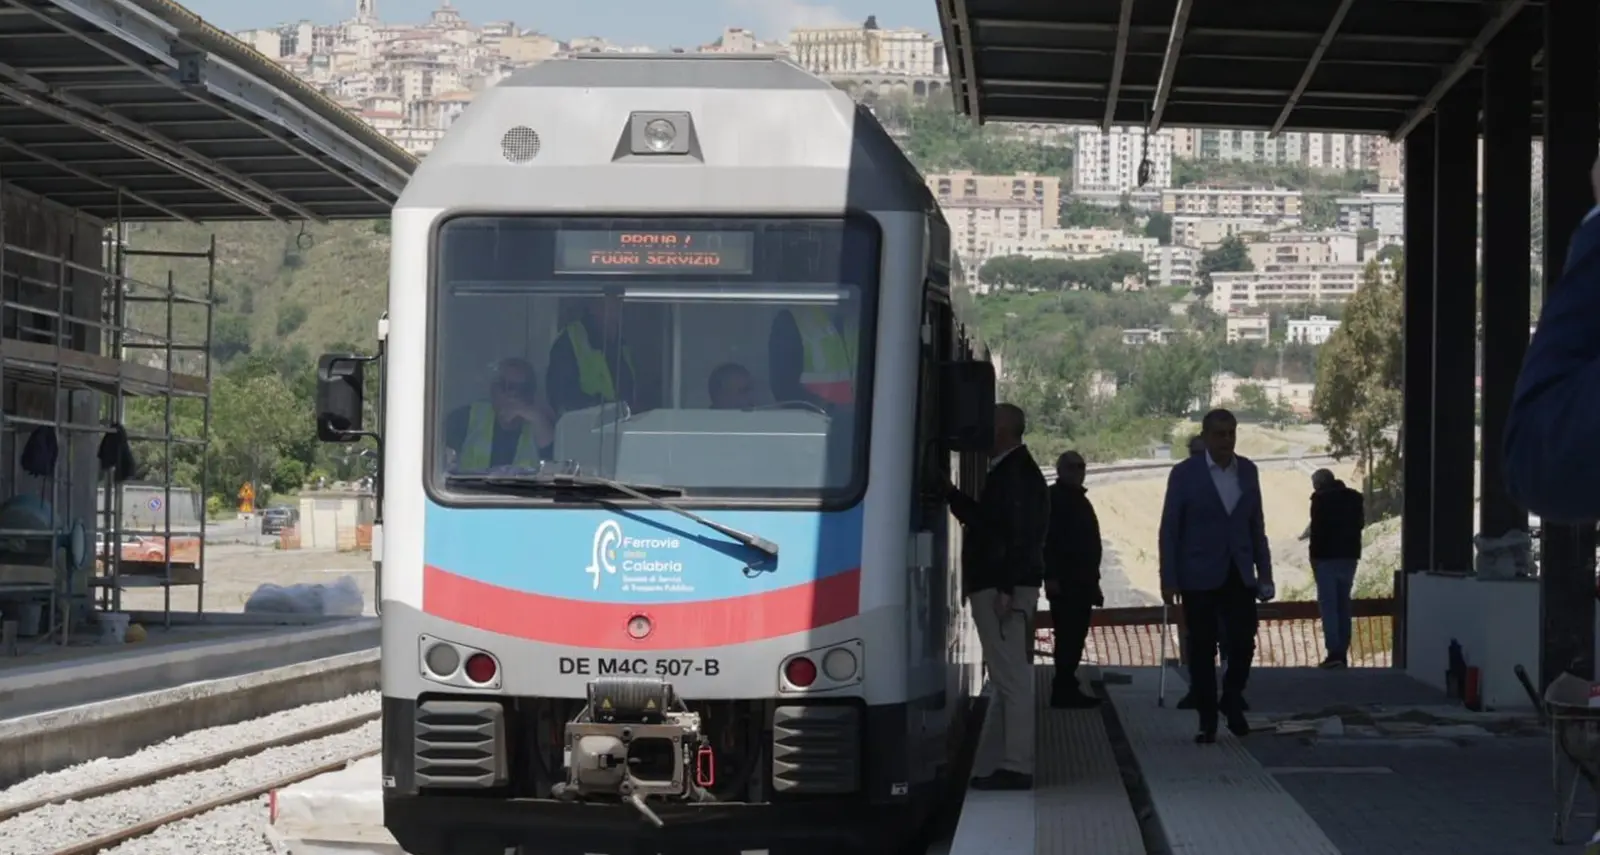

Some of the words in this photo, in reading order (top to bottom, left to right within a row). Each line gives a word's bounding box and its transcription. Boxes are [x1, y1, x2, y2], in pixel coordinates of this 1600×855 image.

[590, 250, 639, 264] FUORI
[645, 250, 721, 265] SERVIZIO
[622, 537, 680, 548] Ferrovie
[622, 560, 682, 572] Calabria
[559, 657, 591, 675] DE
[598, 658, 648, 675] M4C
[655, 659, 720, 676] 507-B
